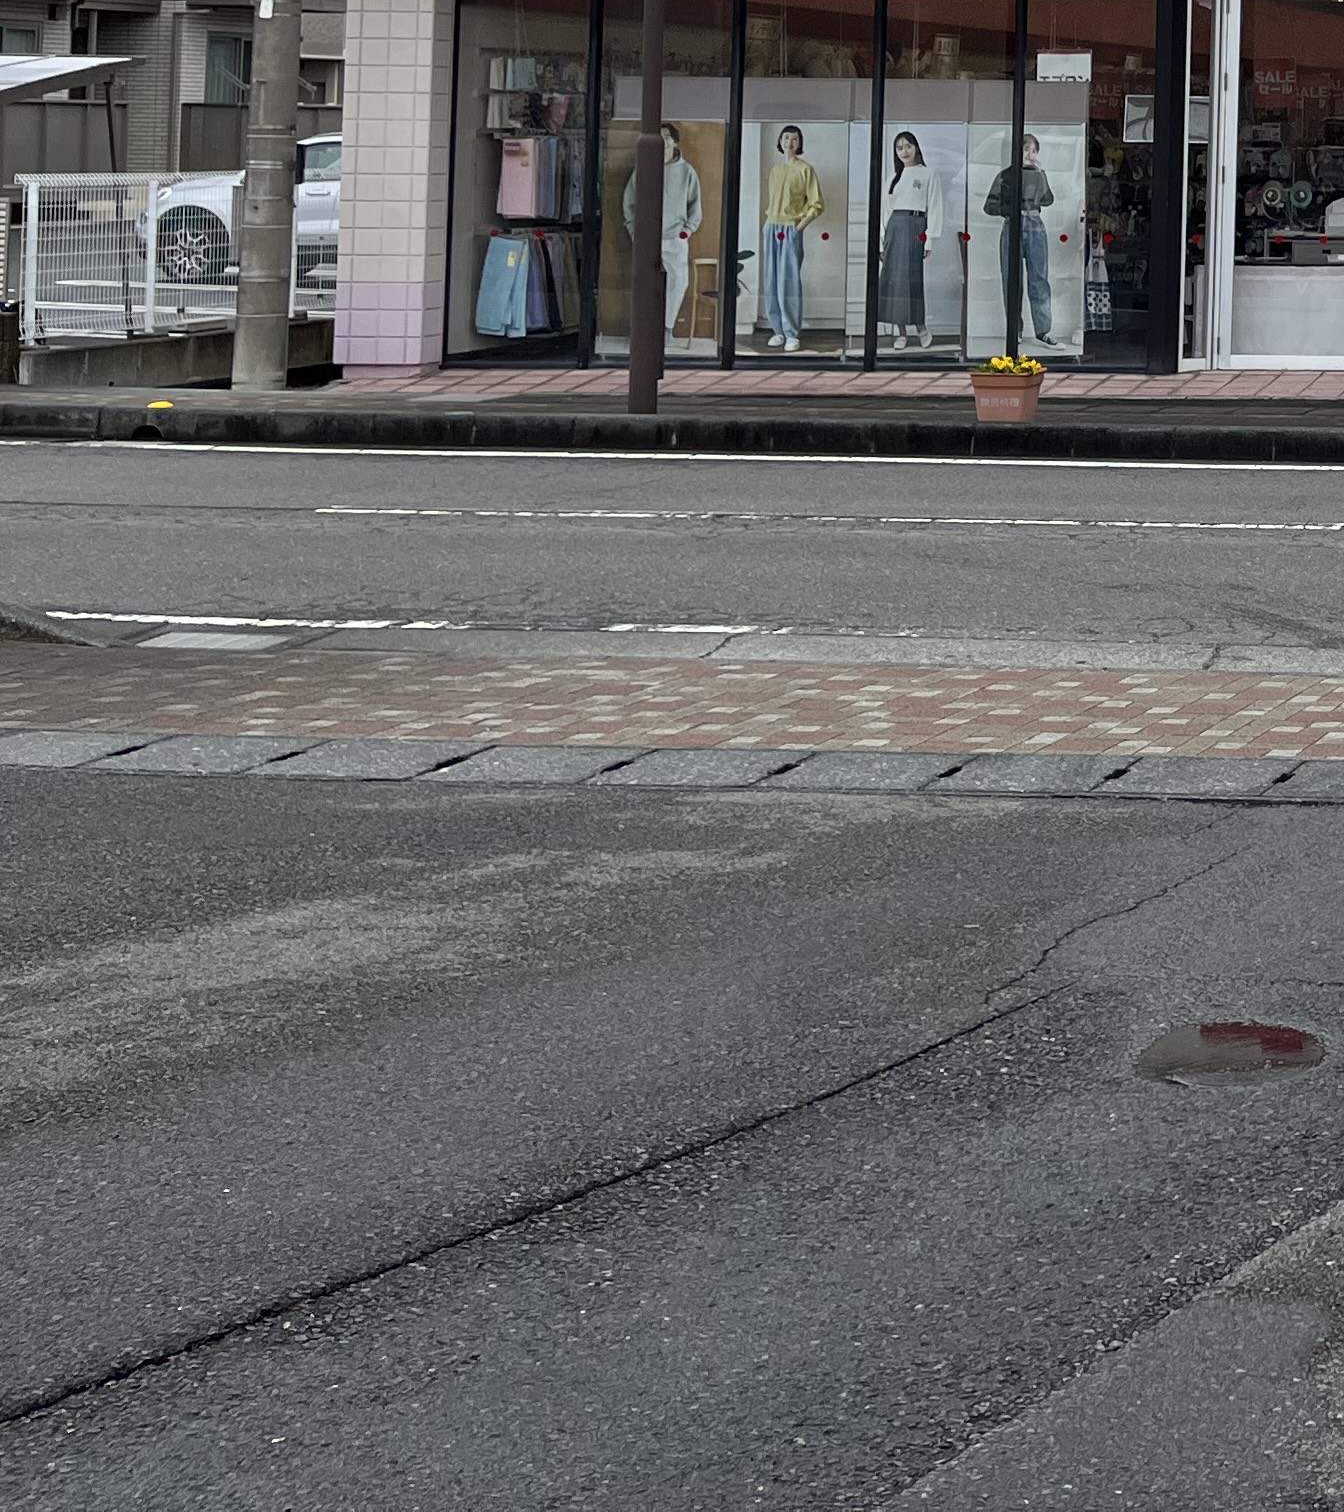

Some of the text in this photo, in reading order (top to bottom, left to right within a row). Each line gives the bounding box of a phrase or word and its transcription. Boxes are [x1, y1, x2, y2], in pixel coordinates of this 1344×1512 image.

[1254, 71, 1296, 84] SALE
[1089, 83, 1121, 97] ALE
[1259, 84, 1293, 95] セール
